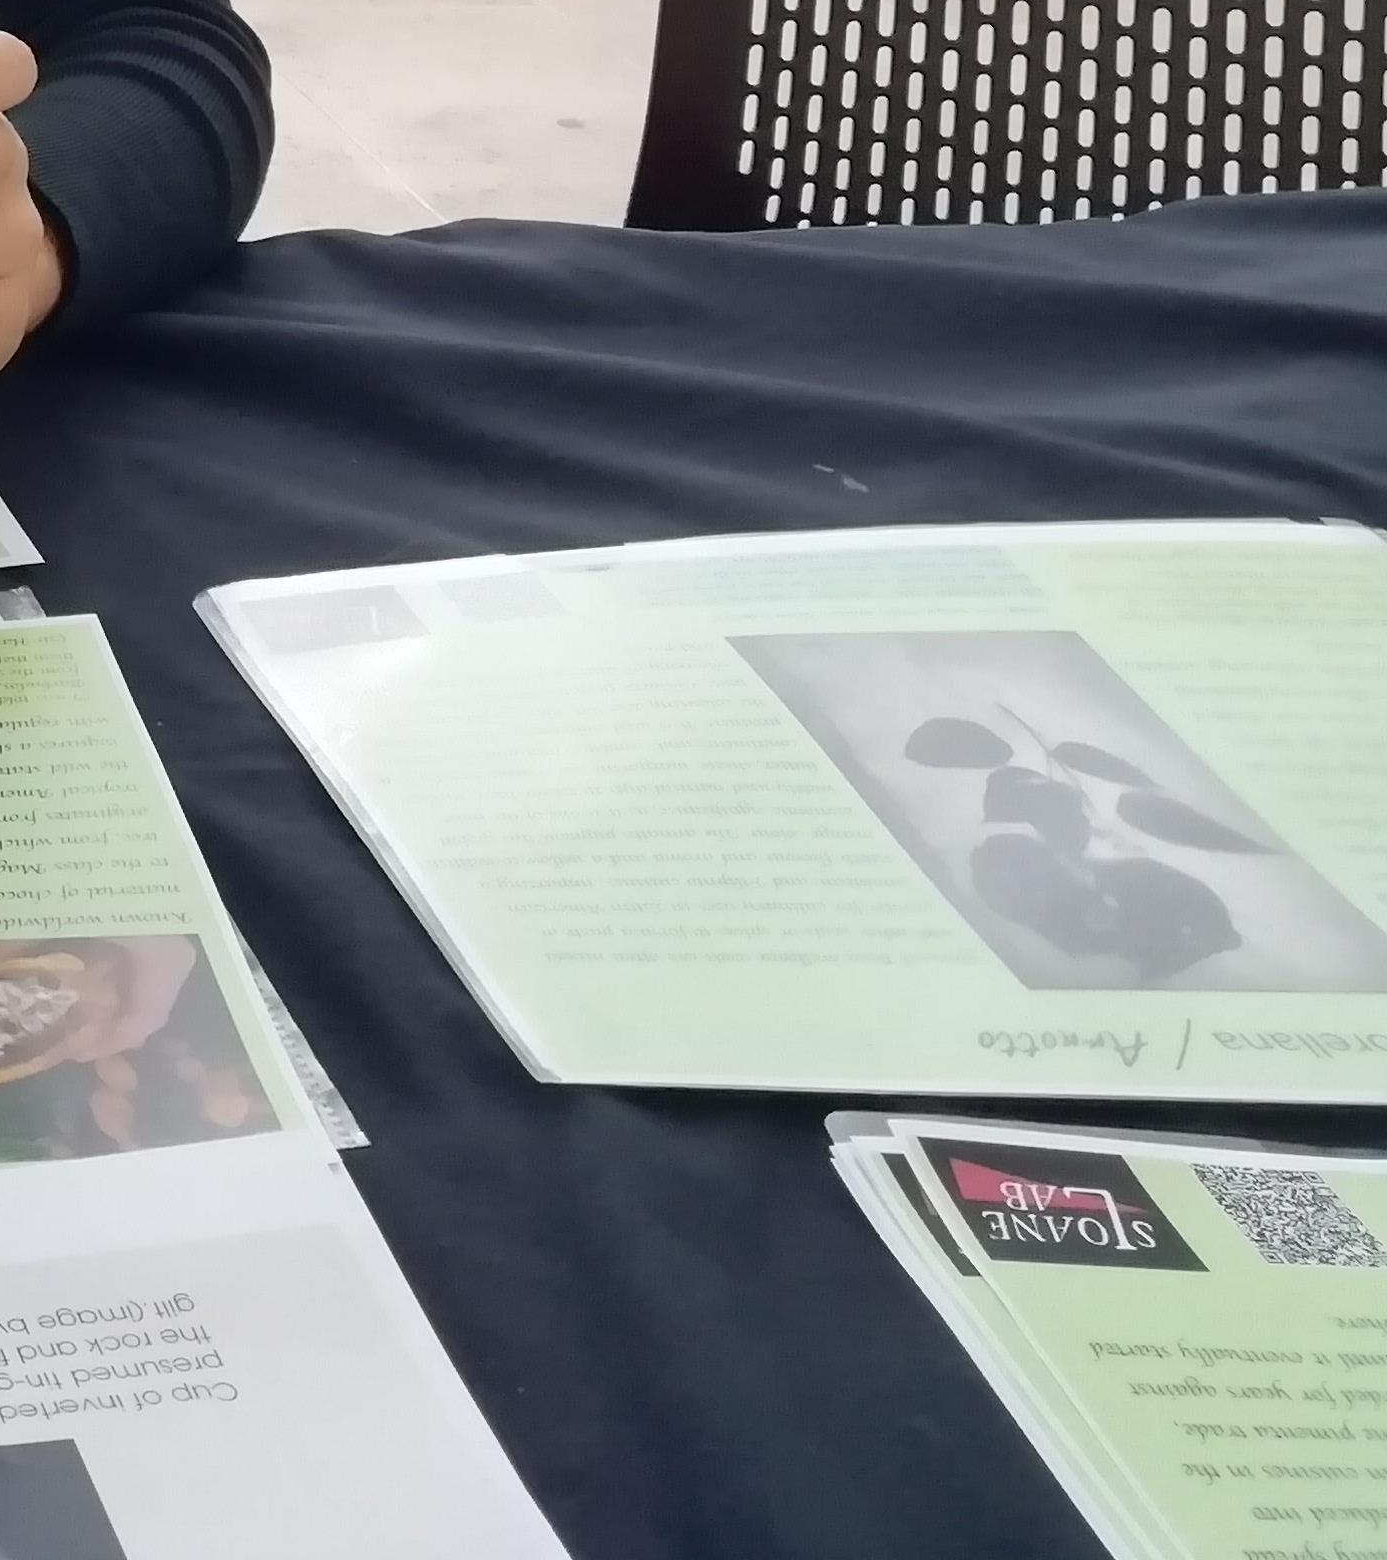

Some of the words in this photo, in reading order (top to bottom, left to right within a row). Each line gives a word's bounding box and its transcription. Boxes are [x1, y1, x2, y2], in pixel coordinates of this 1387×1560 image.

[61, 885, 79, 900] of
[87, 884, 180, 900] material
[111, 912, 192, 924] Known
[978, 1030, 1148, 1068] Arnotto
[981, 1187, 1157, 1250] SLOANE
[85, 1332, 152, 1355] rock
[160, 1326, 210, 1344] the
[16, 1341, 77, 1364] and
[1089, 1342, 1171, 1359] started
[1312, 1352, 1331, 1366] it
[71, 1349, 223, 1387] presumed
[172, 1382, 238, 1401] Cup
[1129, 1376, 1217, 1397] against
[1226, 1380, 1292, 1400] years
[1303, 1381, 1337, 1406] for
[133, 1390, 162, 1411] of
[1173, 1421, 1247, 1444] trade,
[1253, 1421, 1355, 1440] pimenta
[1182, 1464, 1221, 1485] the
[1227, 1465, 1255, 1478] in
[1261, 1466, 1357, 1480] cuisines
